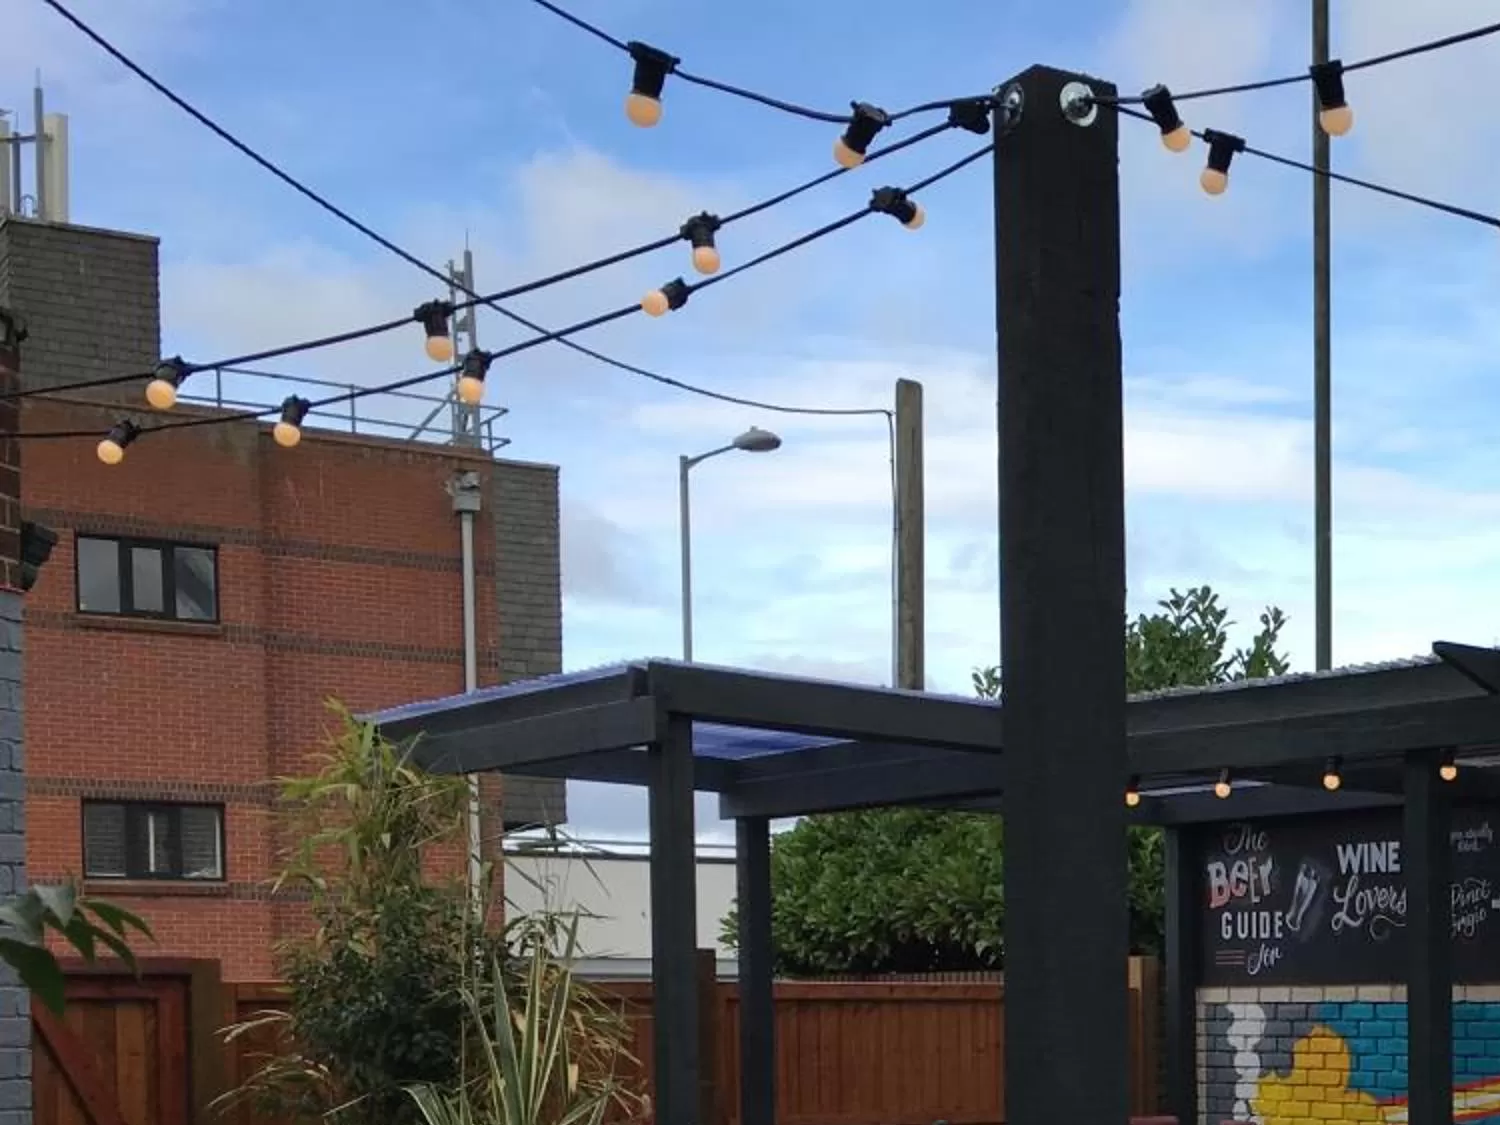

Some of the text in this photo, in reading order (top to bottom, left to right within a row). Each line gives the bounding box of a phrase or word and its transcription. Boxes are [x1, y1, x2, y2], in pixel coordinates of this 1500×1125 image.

[1336, 841, 1401, 874] WINE
[1331, 875, 1407, 933] Lovers
[1221, 911, 1283, 939] GUIDE
